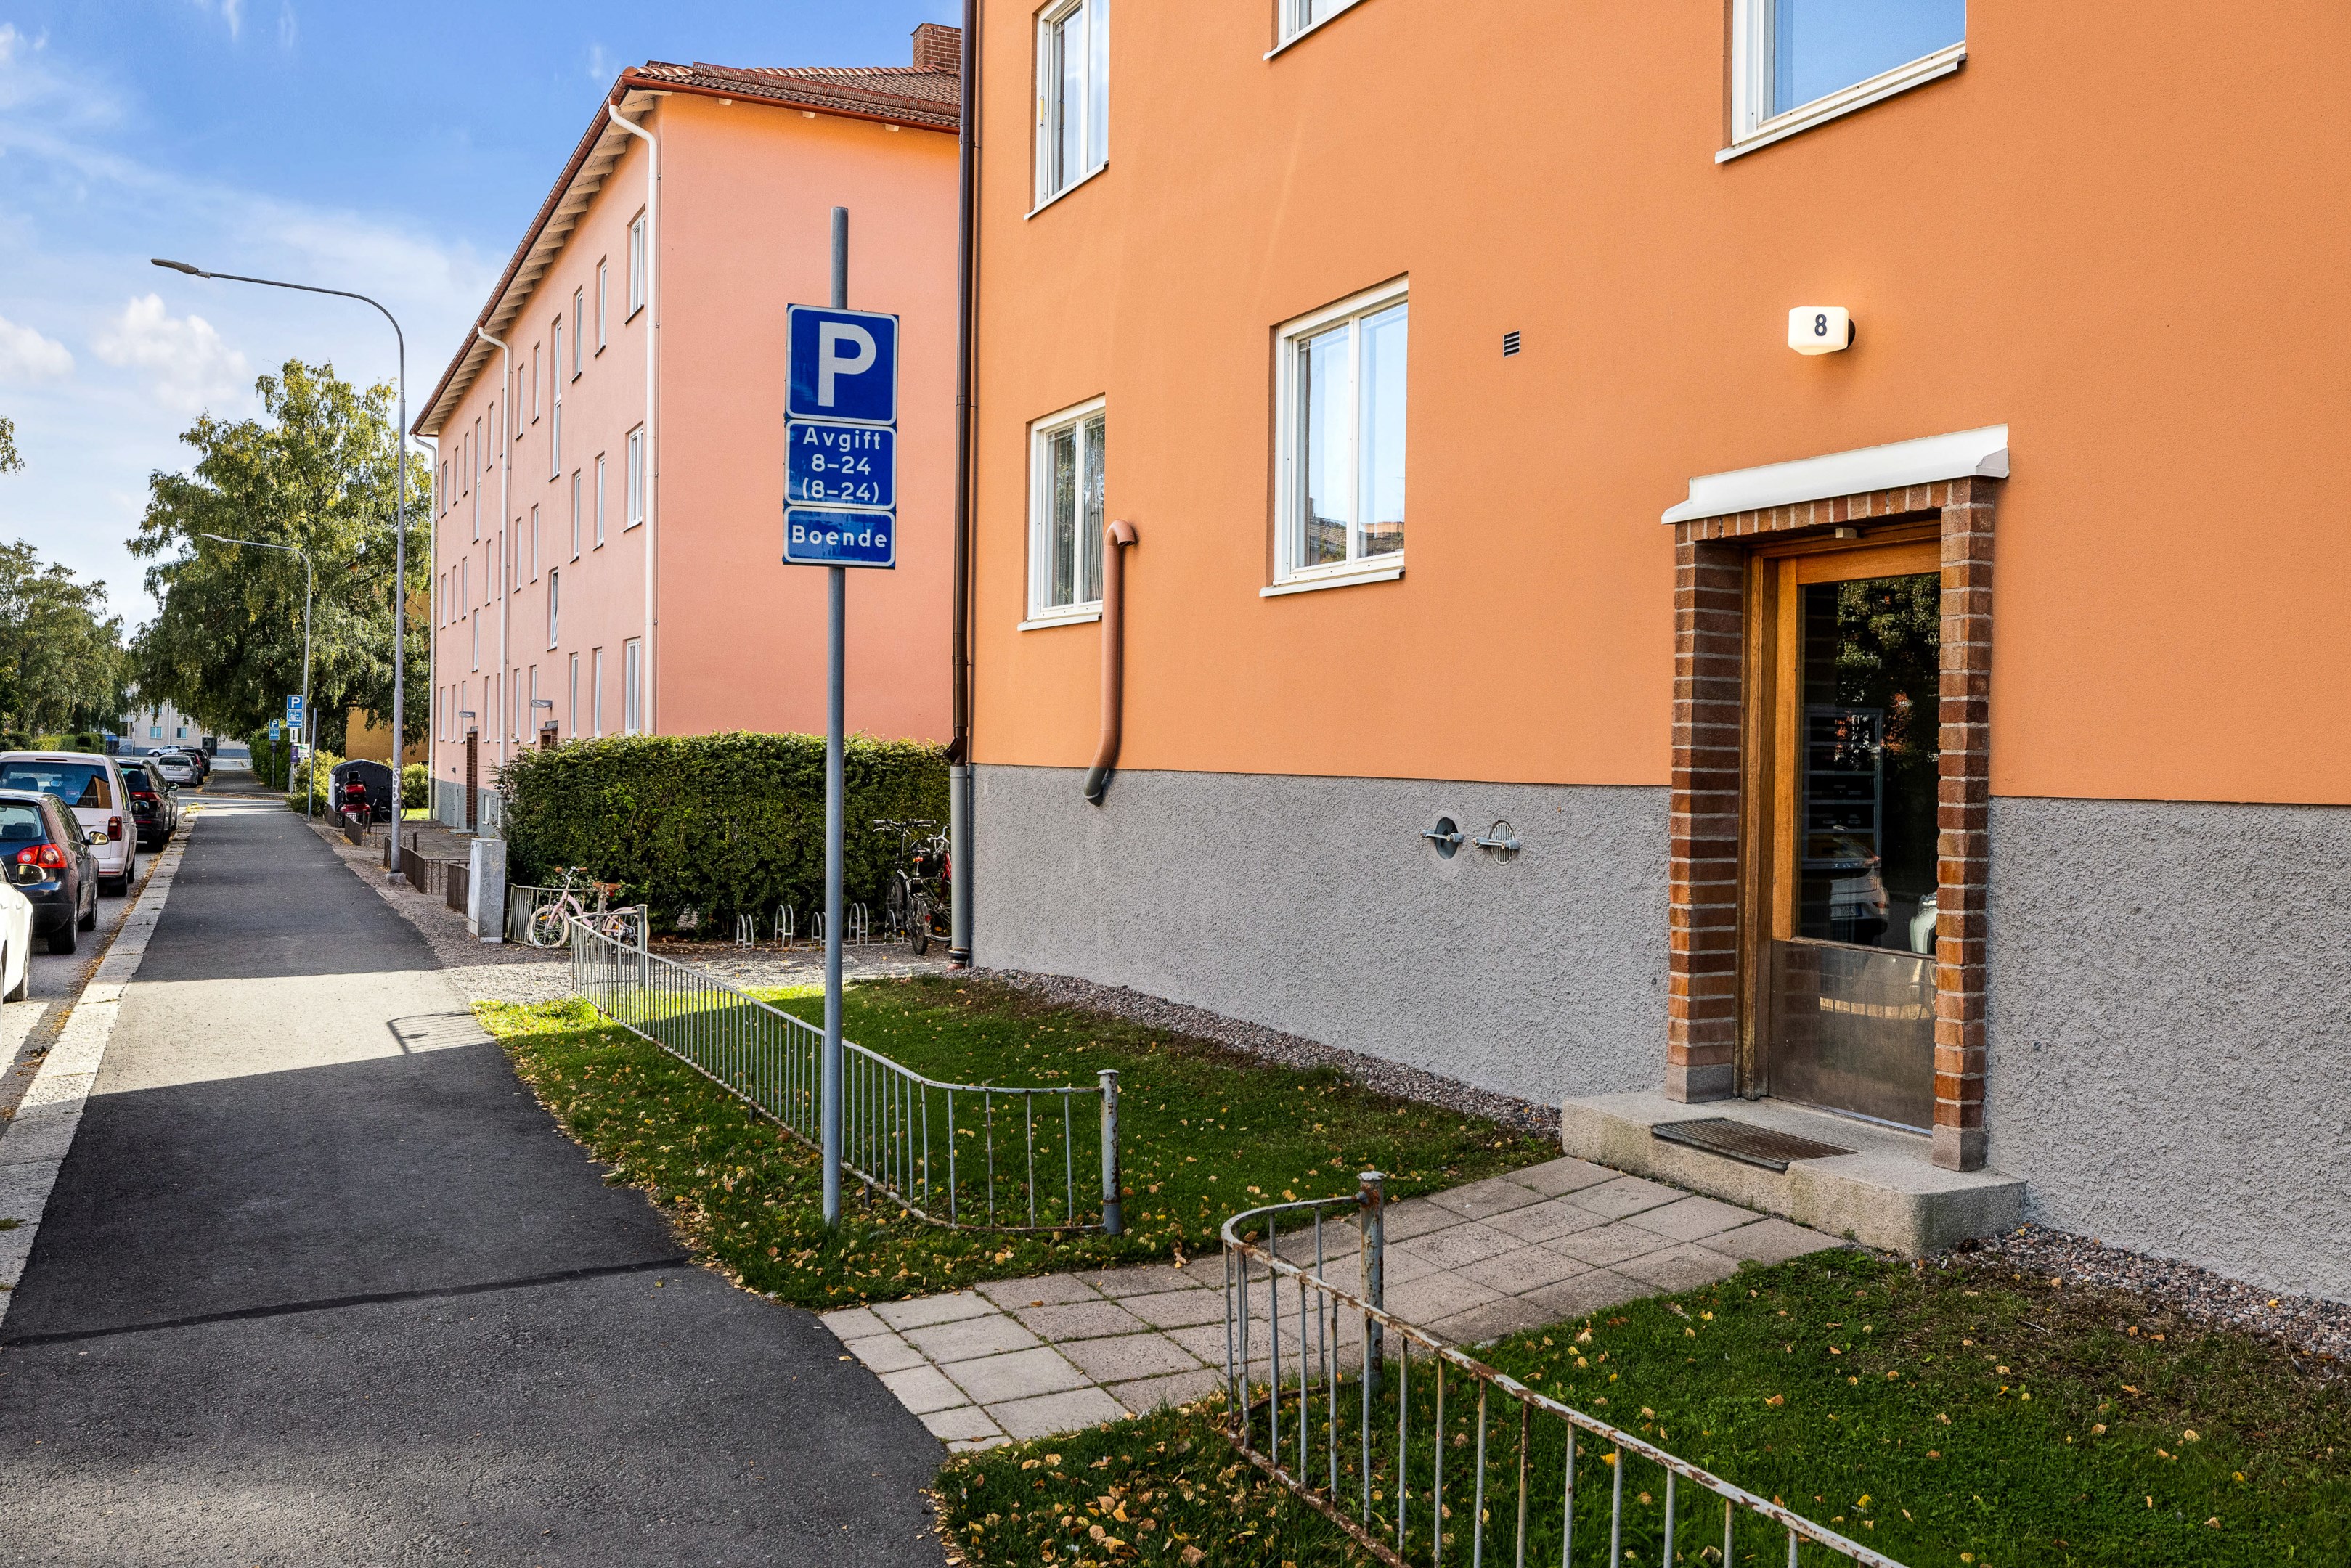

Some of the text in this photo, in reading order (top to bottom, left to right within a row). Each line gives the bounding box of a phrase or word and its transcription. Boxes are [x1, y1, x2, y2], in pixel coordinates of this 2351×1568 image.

[1814, 314, 1828, 337] 8
[818, 320, 877, 407] P
[802, 426, 881, 452] Avgift
[812, 454, 871, 475] 8-24
[802, 477, 879, 504] (8-24)
[791, 525, 887, 548] Boende
[291, 696, 301, 709] P
